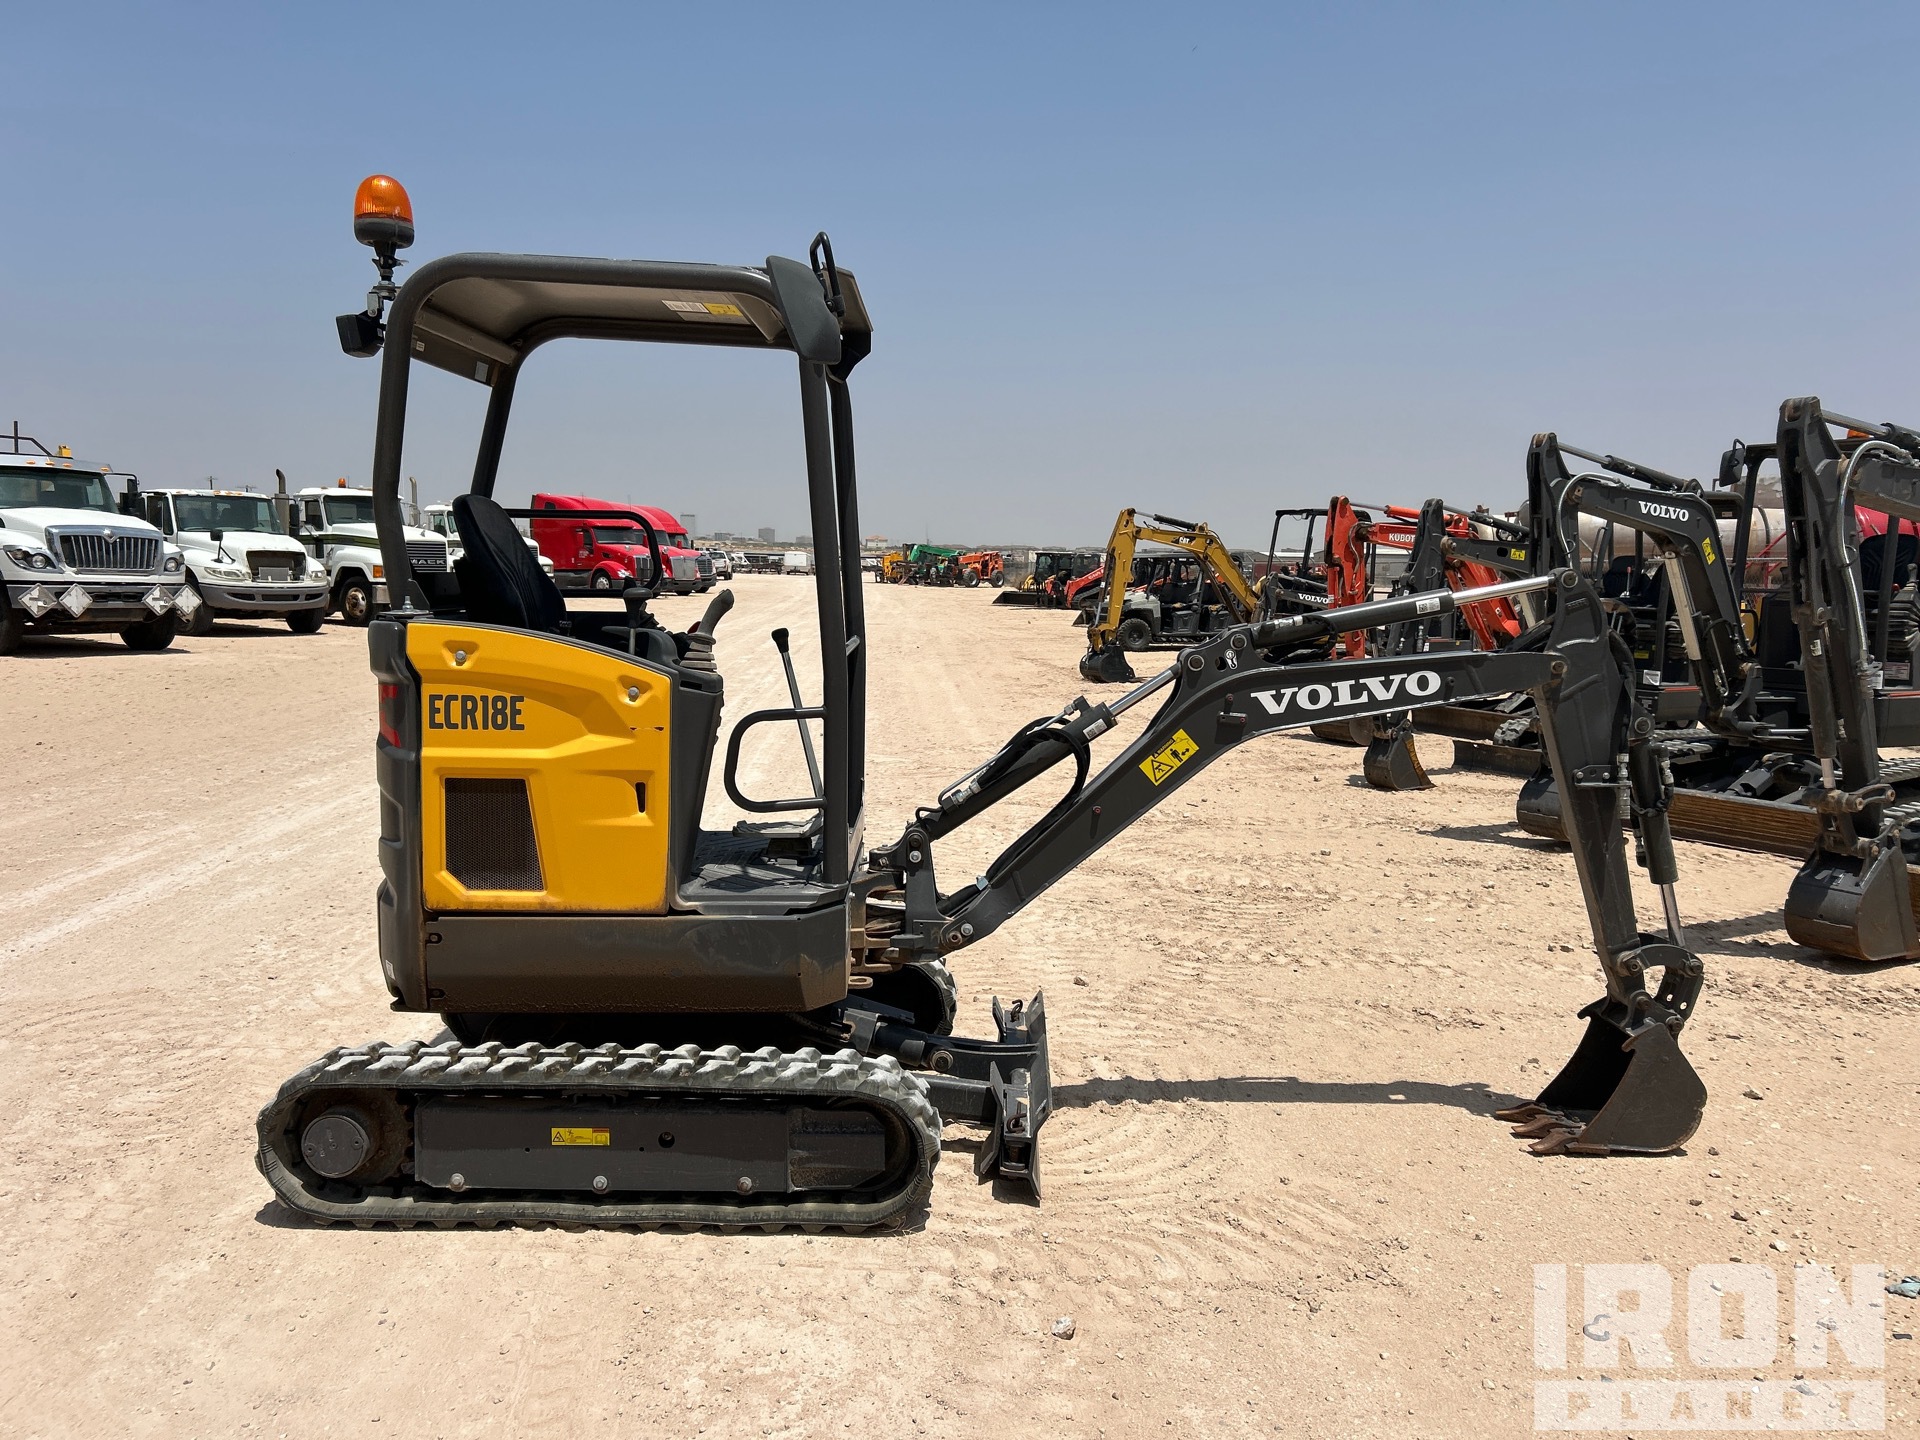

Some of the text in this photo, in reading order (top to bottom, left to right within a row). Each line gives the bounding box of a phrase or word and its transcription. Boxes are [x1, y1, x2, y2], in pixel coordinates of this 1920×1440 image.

[1638, 501, 1689, 522] VOLVO
[1179, 537, 1190, 545] CAT
[1297, 593, 1329, 605] VOLVO
[1250, 670, 1442, 716] VOLVO
[428, 694, 525, 732] ECR18E
